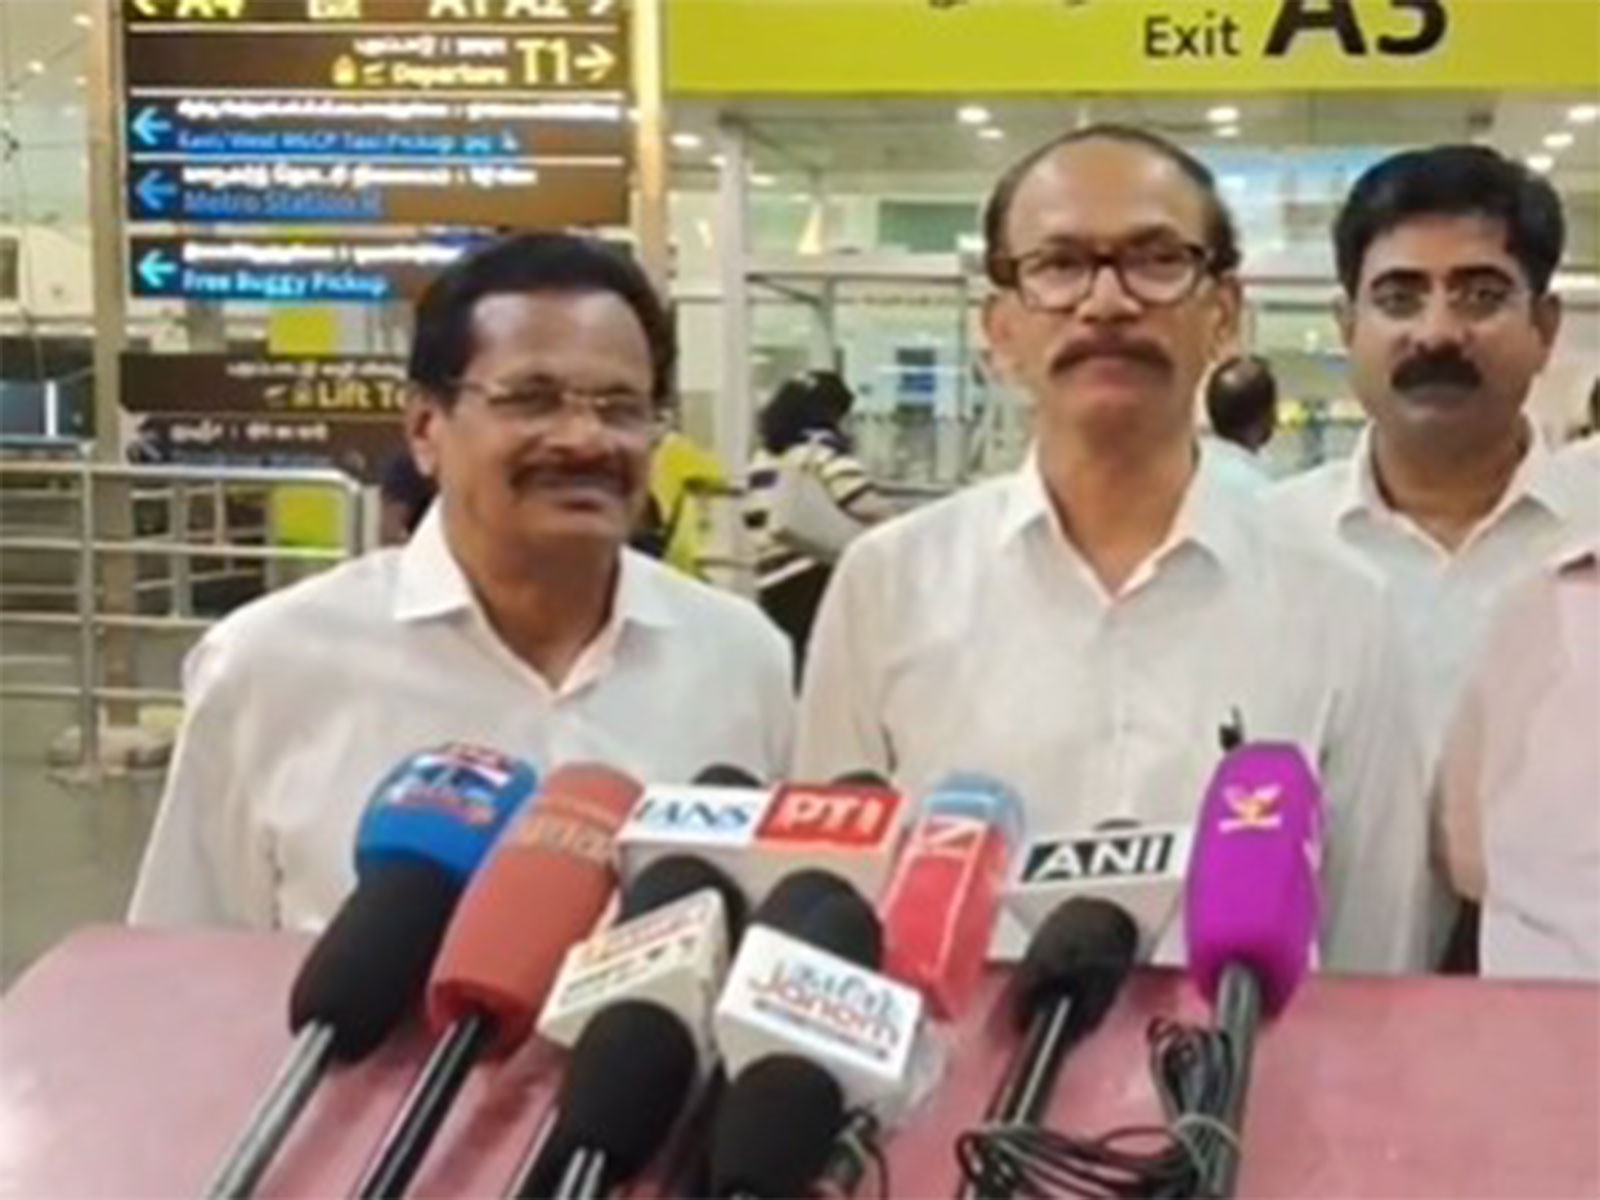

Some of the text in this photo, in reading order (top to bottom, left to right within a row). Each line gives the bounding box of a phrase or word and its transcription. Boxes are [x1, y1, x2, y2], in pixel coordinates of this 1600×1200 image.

[1144, 0, 1448, 57] Exit A3
[392, 64, 507, 88] Departure
[514, 38, 569, 85] T1
[182, 189, 356, 213] Metro Station
[182, 270, 387, 299] Free Buggy Pickup
[318, 381, 371, 408] Lift
[633, 798, 753, 830] IANS
[782, 791, 884, 836] PTI
[1028, 834, 1168, 882] ANI
